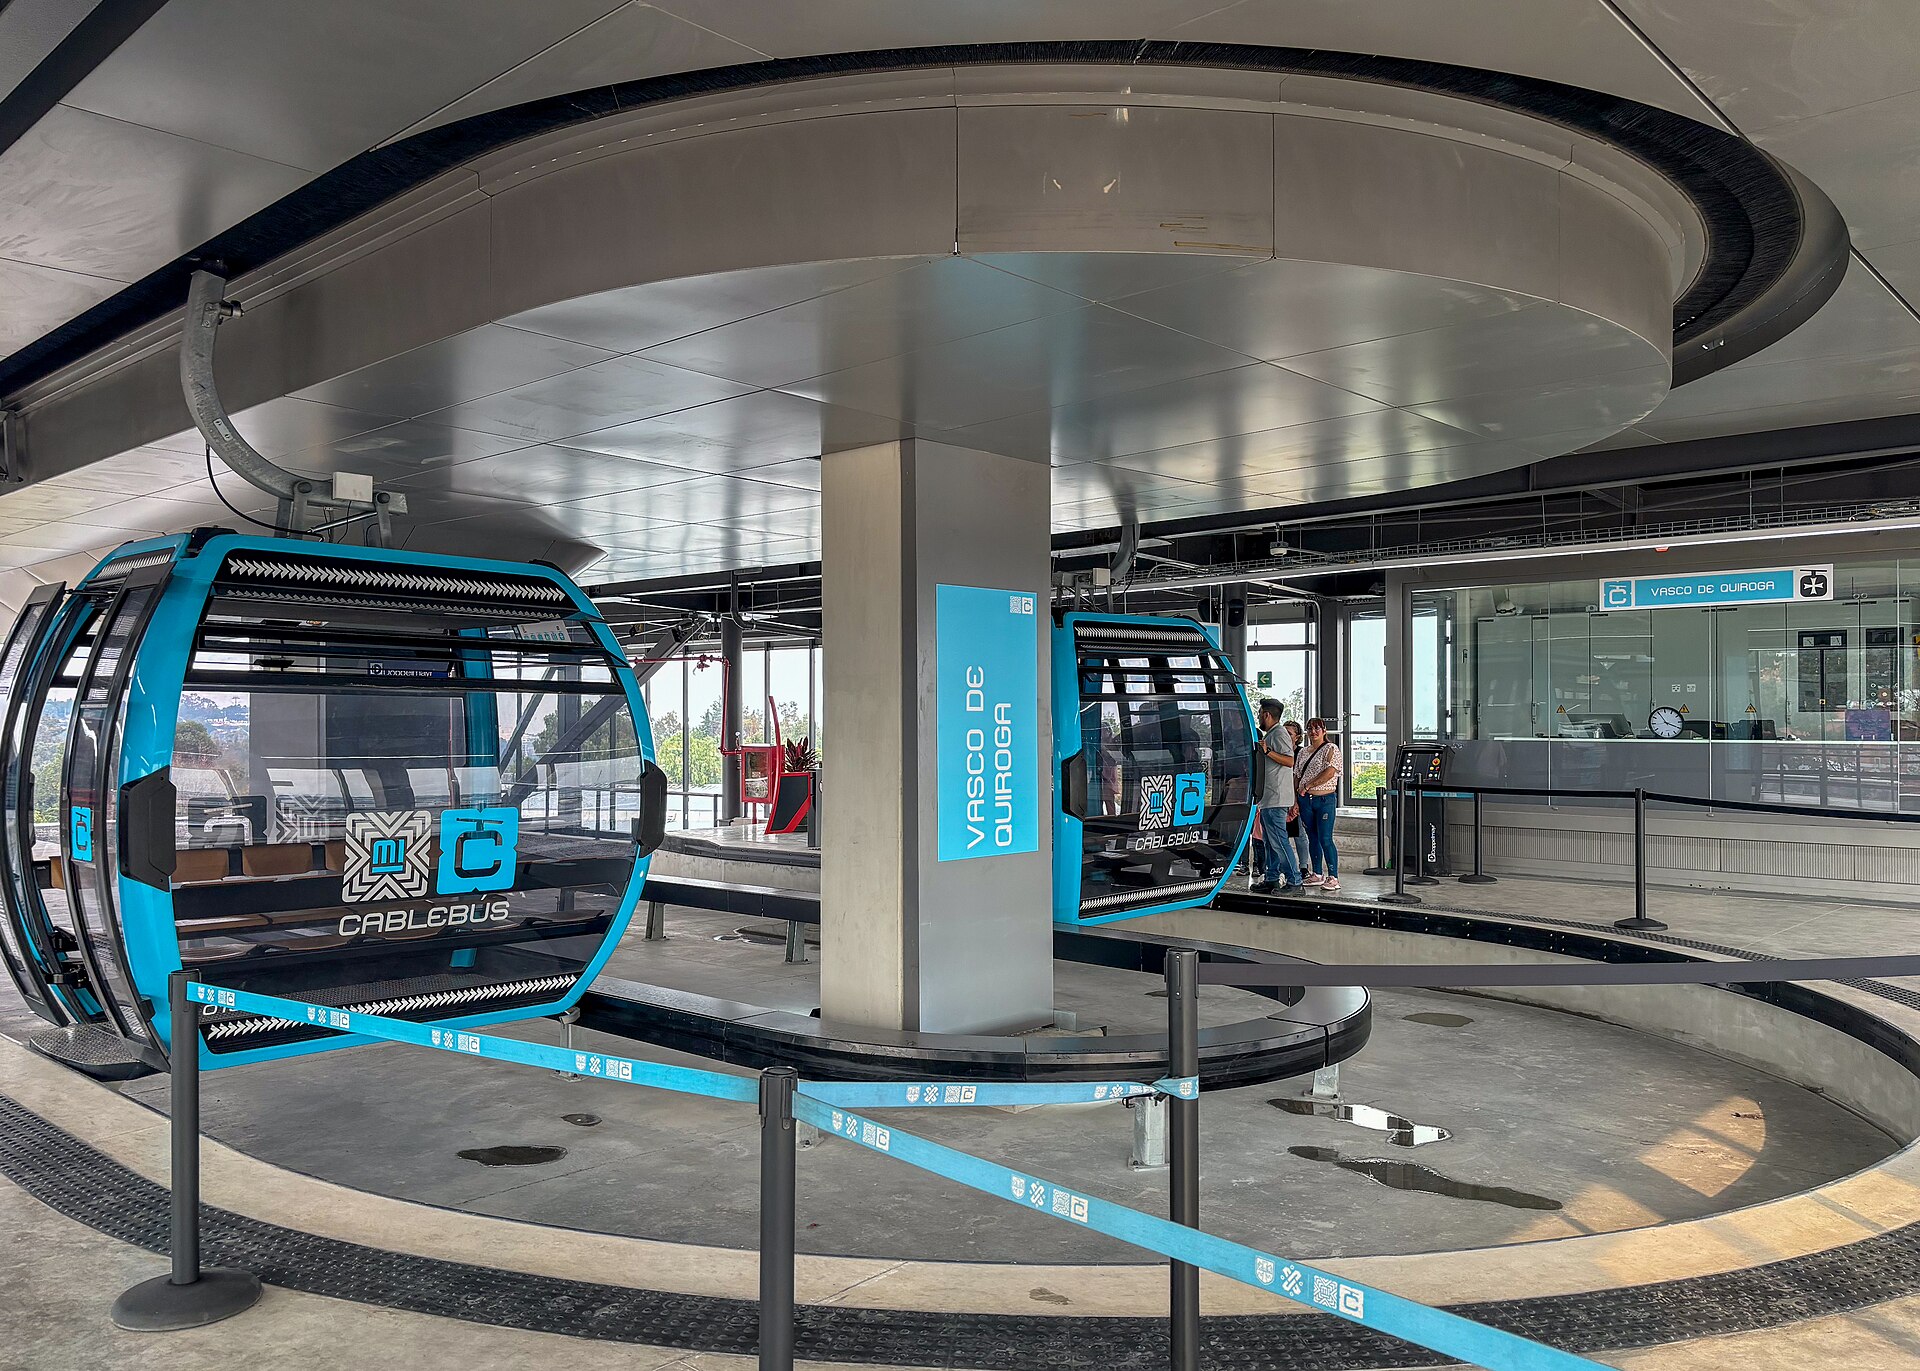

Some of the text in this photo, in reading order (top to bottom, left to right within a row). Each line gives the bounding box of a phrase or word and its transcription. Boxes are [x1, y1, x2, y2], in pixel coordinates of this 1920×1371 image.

[1650, 581, 1775, 597] VASCO DE QUIROGA
[966, 665, 985, 850] VASCO DE
[994, 702, 1013, 848] QUIROGA
[1135, 826, 1200, 851] CABLEBÚS
[338, 894, 510, 937] CABLEBÚS
